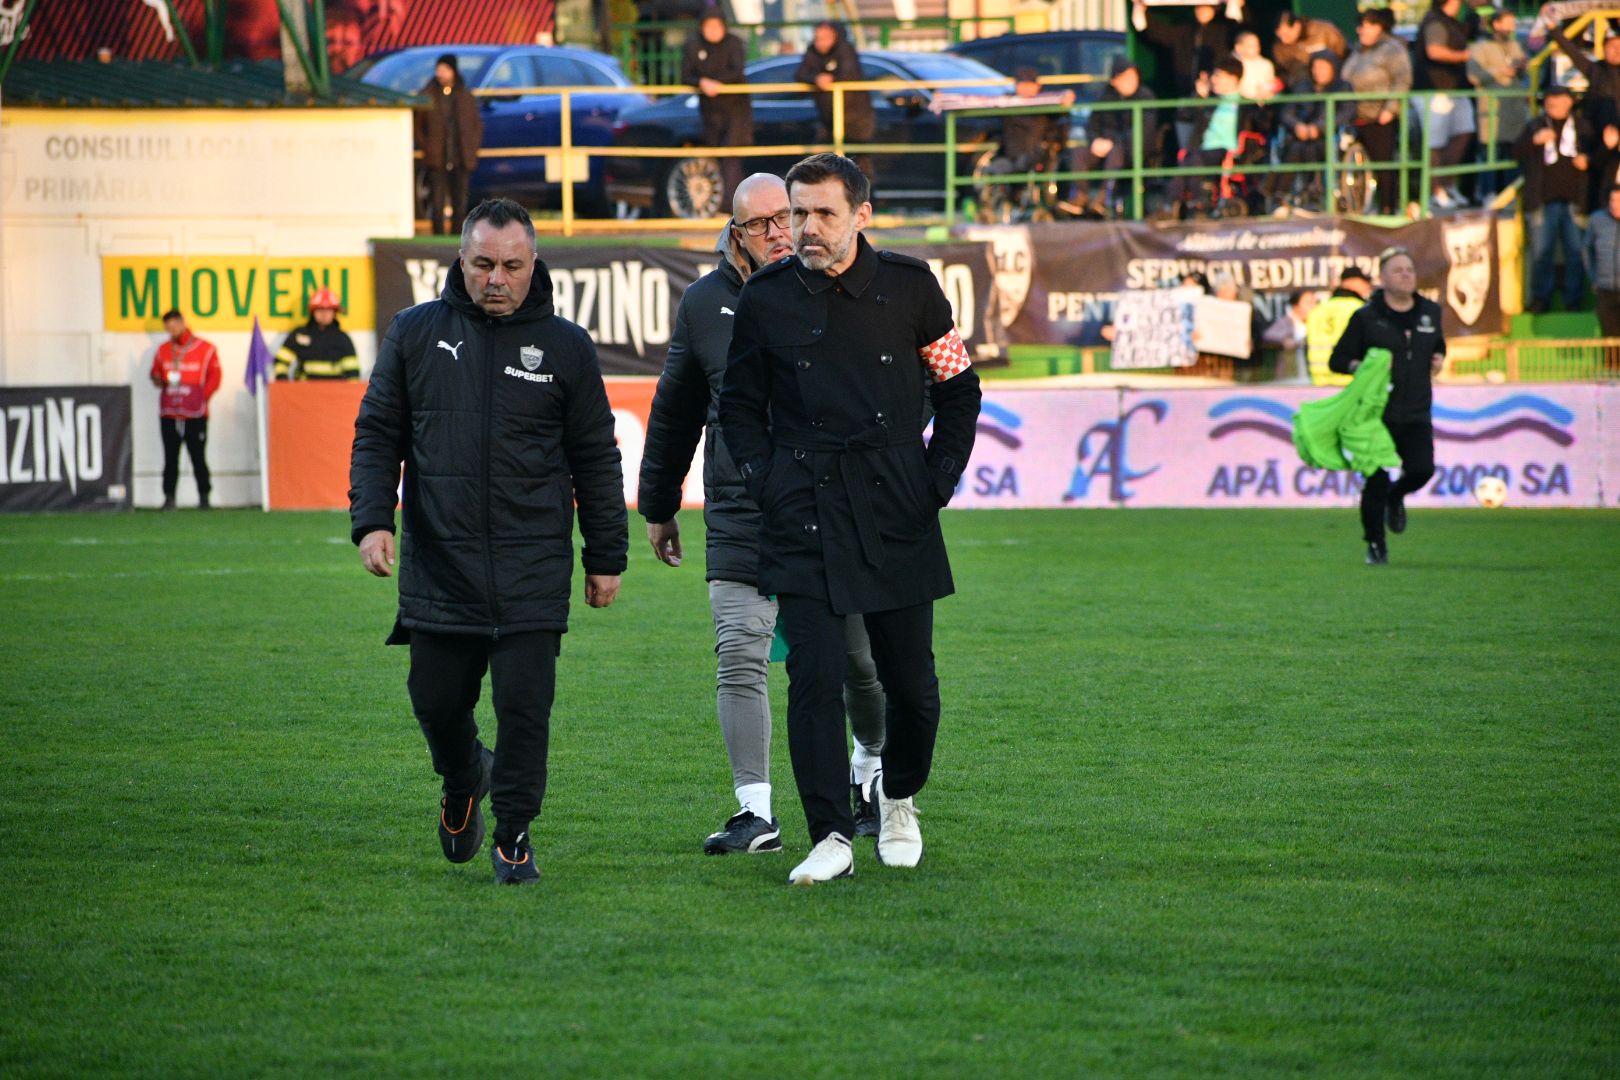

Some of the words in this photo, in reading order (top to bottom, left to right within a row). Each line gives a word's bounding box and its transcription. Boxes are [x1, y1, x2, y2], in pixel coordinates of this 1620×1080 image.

[44, 134, 177, 161] CONSILIUL
[120, 267, 349, 319] MIOVENI
[503, 365, 554, 383] SUPERBET
[973, 464, 1020, 497] SA
[1207, 459, 1281, 497] APĂ
[1520, 462, 1570, 497] SA
